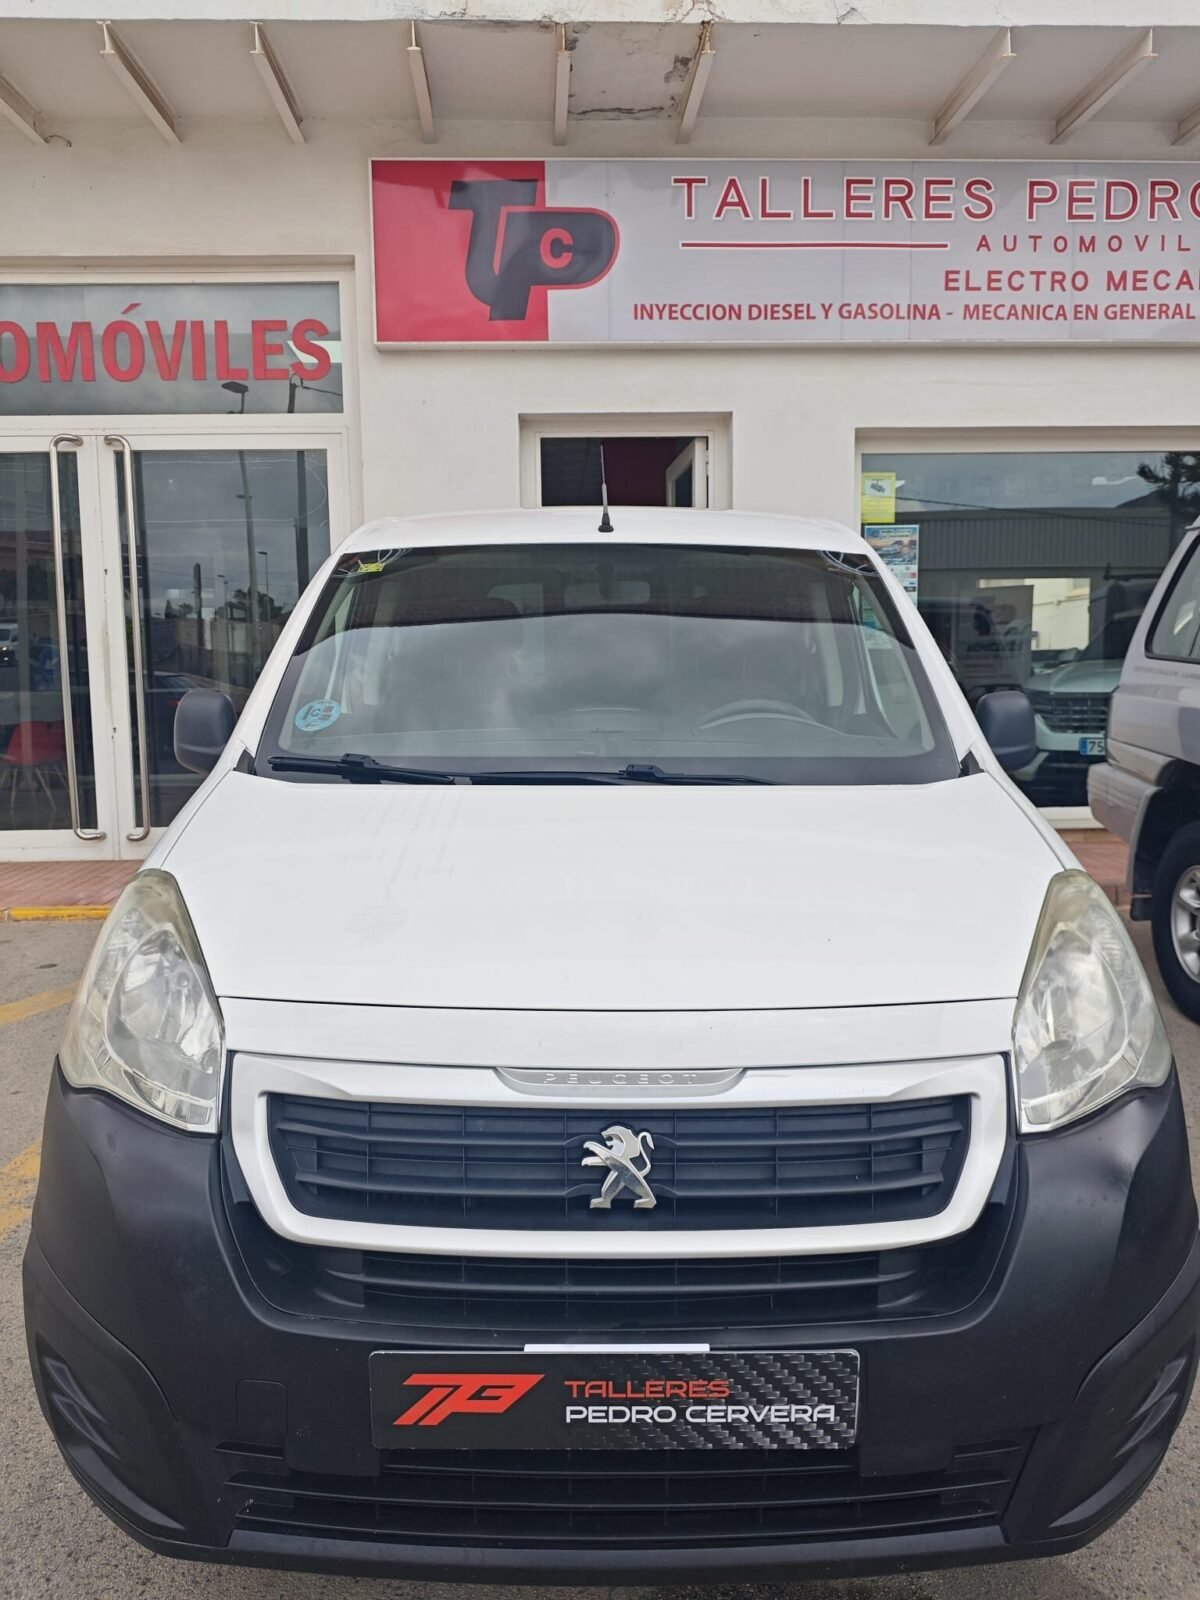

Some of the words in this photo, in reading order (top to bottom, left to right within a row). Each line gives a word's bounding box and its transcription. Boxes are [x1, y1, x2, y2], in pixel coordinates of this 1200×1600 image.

[671, 175, 995, 222] TALLERES
[976, 234, 1191, 253] AUTOMOVIL
[944, 269, 1089, 292] ELECTRO
[1106, 269, 1200, 292] MECA
[633, 303, 742, 321] INYECCION
[748, 303, 816, 321] DIESEL
[821, 303, 833, 320] Y
[838, 302, 941, 320] GASOLINA
[962, 303, 1067, 322] MECANICA
[1073, 303, 1098, 321] EN
[1103, 302, 1196, 321] GENERAL
[0, 302, 332, 384] OMÓVILES
[543, 1073, 697, 1085] PEUGEOT
[564, 1380, 730, 1398] TALLERES
[565, 1405, 677, 1423] PEDRO
[685, 1404, 836, 1423] CERVERA
